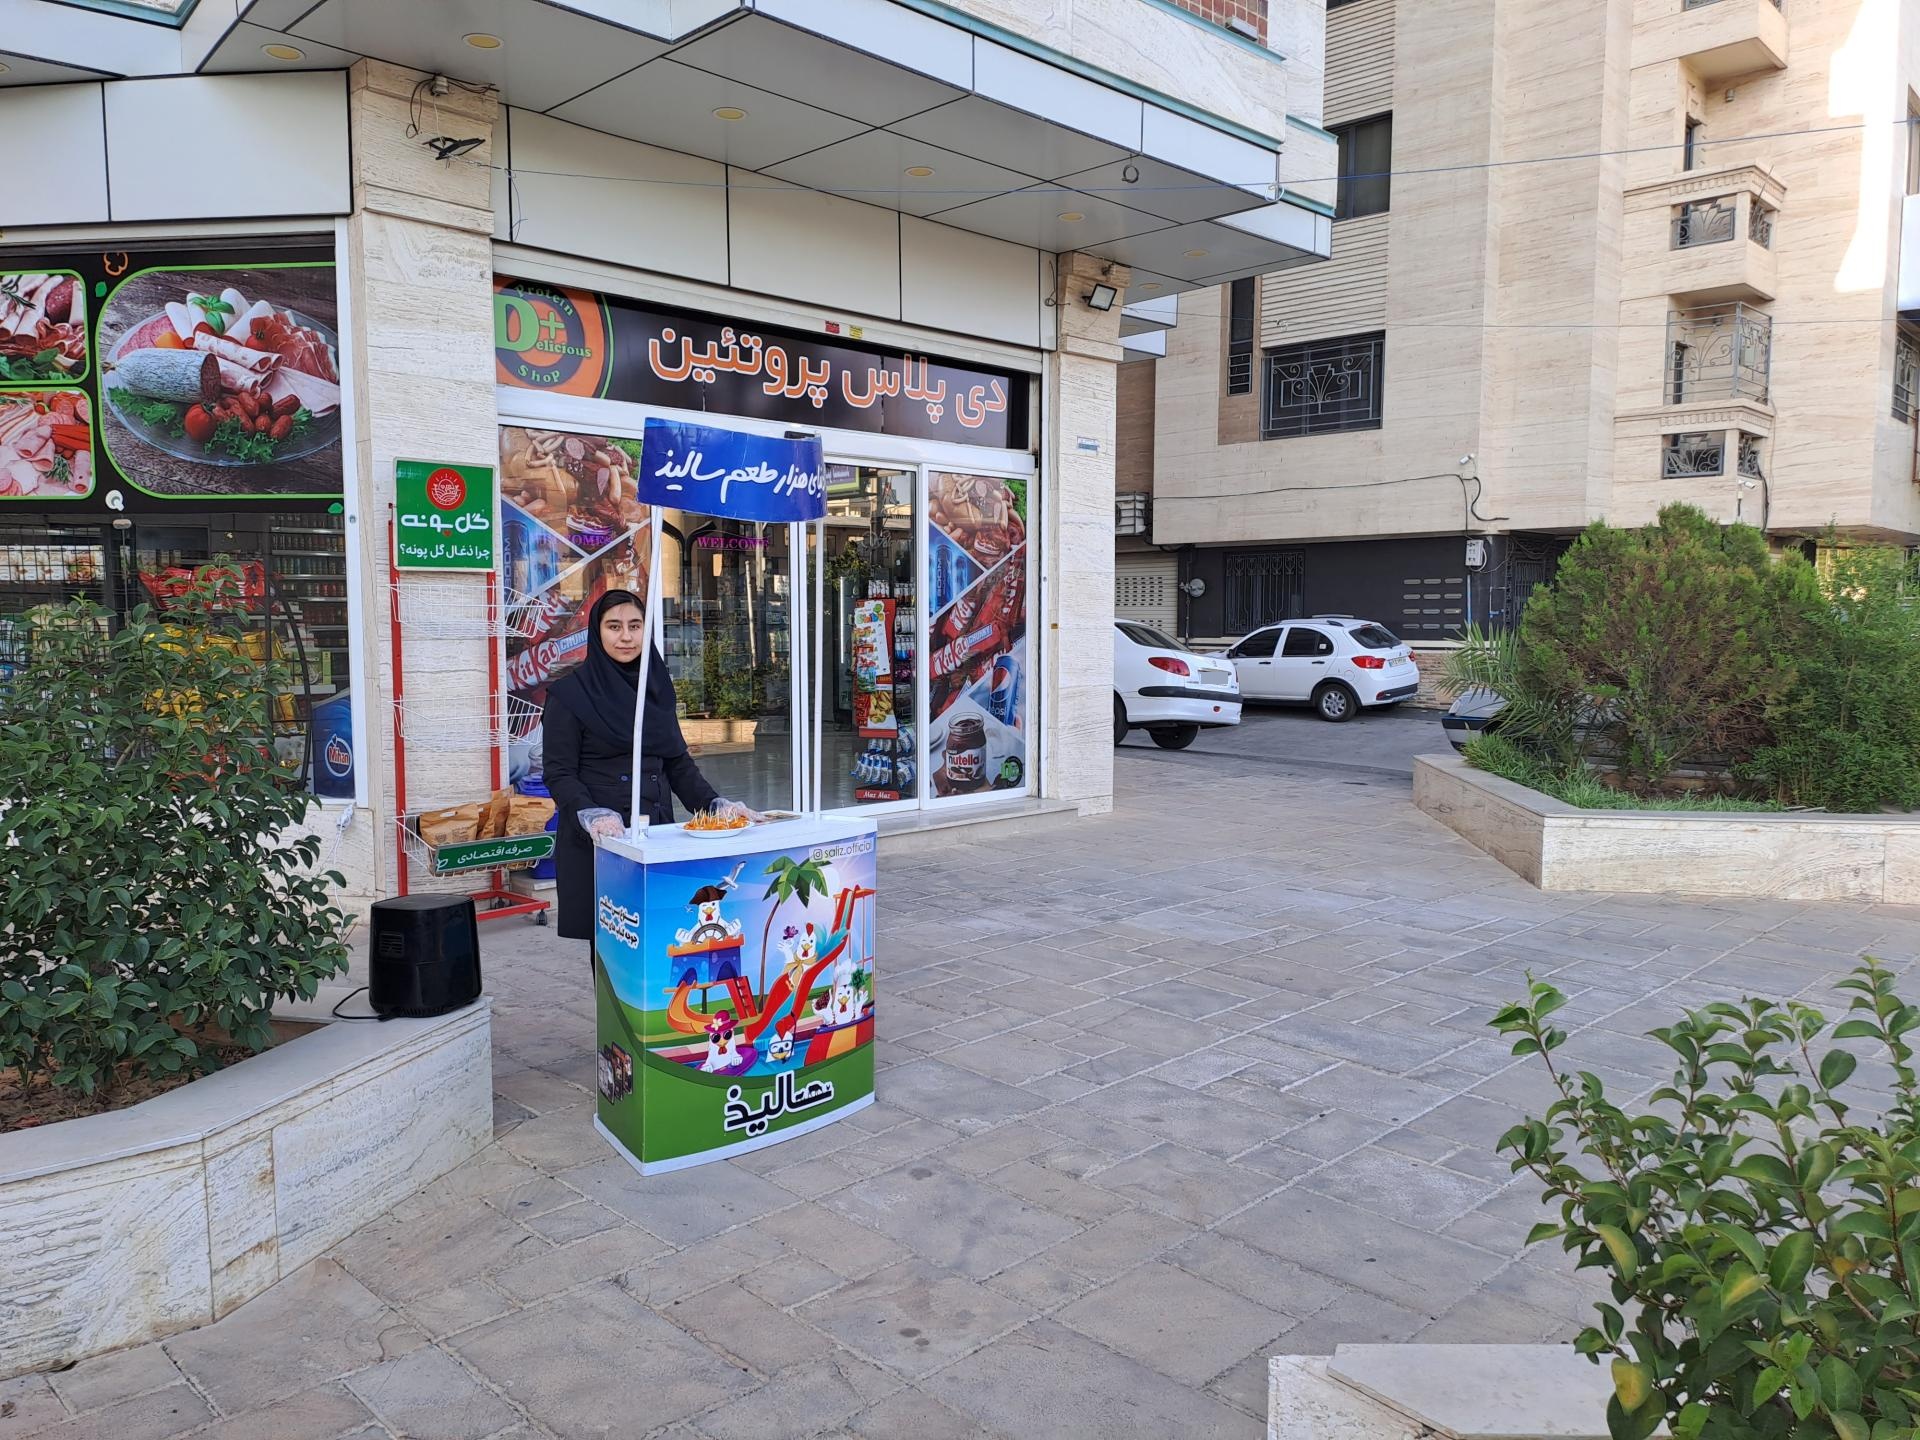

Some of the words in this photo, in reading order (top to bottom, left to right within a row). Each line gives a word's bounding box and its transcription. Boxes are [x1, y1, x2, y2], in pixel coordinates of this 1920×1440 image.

[517, 363, 561, 384] Shop
[648, 326, 831, 409] پروتئین
[842, 354, 946, 424] پلاس
[955, 378, 1007, 428] دی
[720, 461, 778, 504] طعم
[773, 463, 808, 497] هزار
[401, 513, 454, 537] پونه
[455, 512, 490, 534] گل
[430, 544, 445, 558] گل
[446, 544, 474, 559] ذغال
[474, 544, 490, 561] چرا
[507, 640, 560, 692] KitKat
[329, 747, 349, 765] Mihan
[948, 754, 979, 766] nutella
[457, 846, 505, 864] اقتصادی
[505, 844, 533, 857] صرفه
